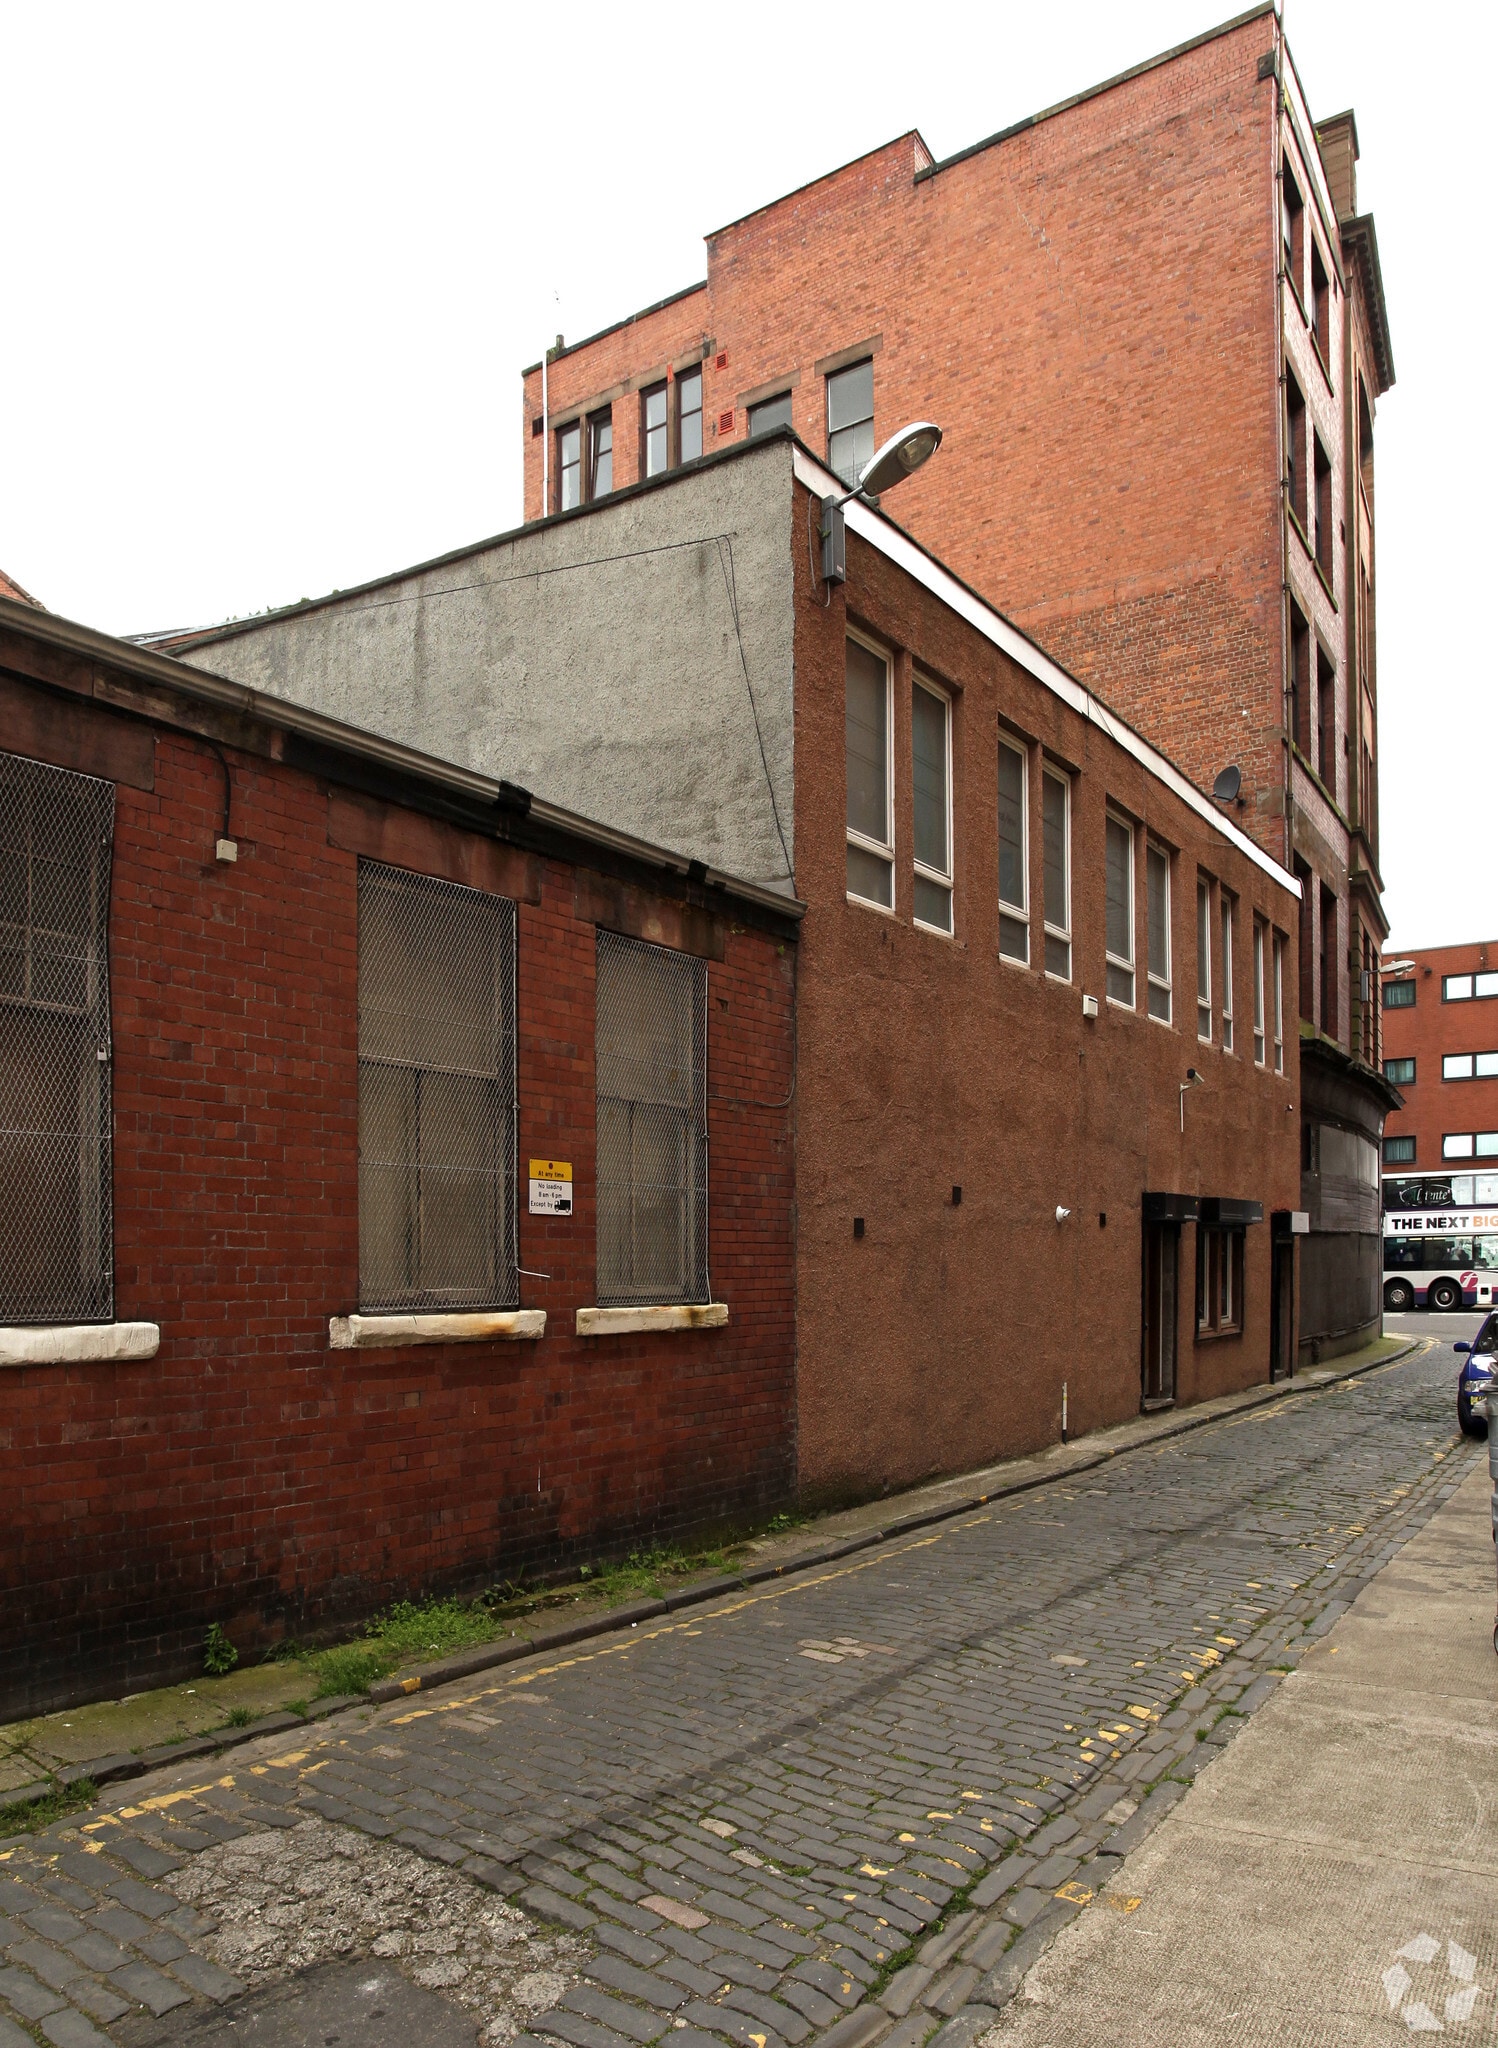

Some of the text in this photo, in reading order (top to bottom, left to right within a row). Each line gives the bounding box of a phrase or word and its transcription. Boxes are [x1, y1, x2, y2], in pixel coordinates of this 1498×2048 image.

[530, 1200, 546, 1208] Except
[1392, 1218, 1423, 1230] THE
[1426, 1216, 1469, 1229] NEXT
